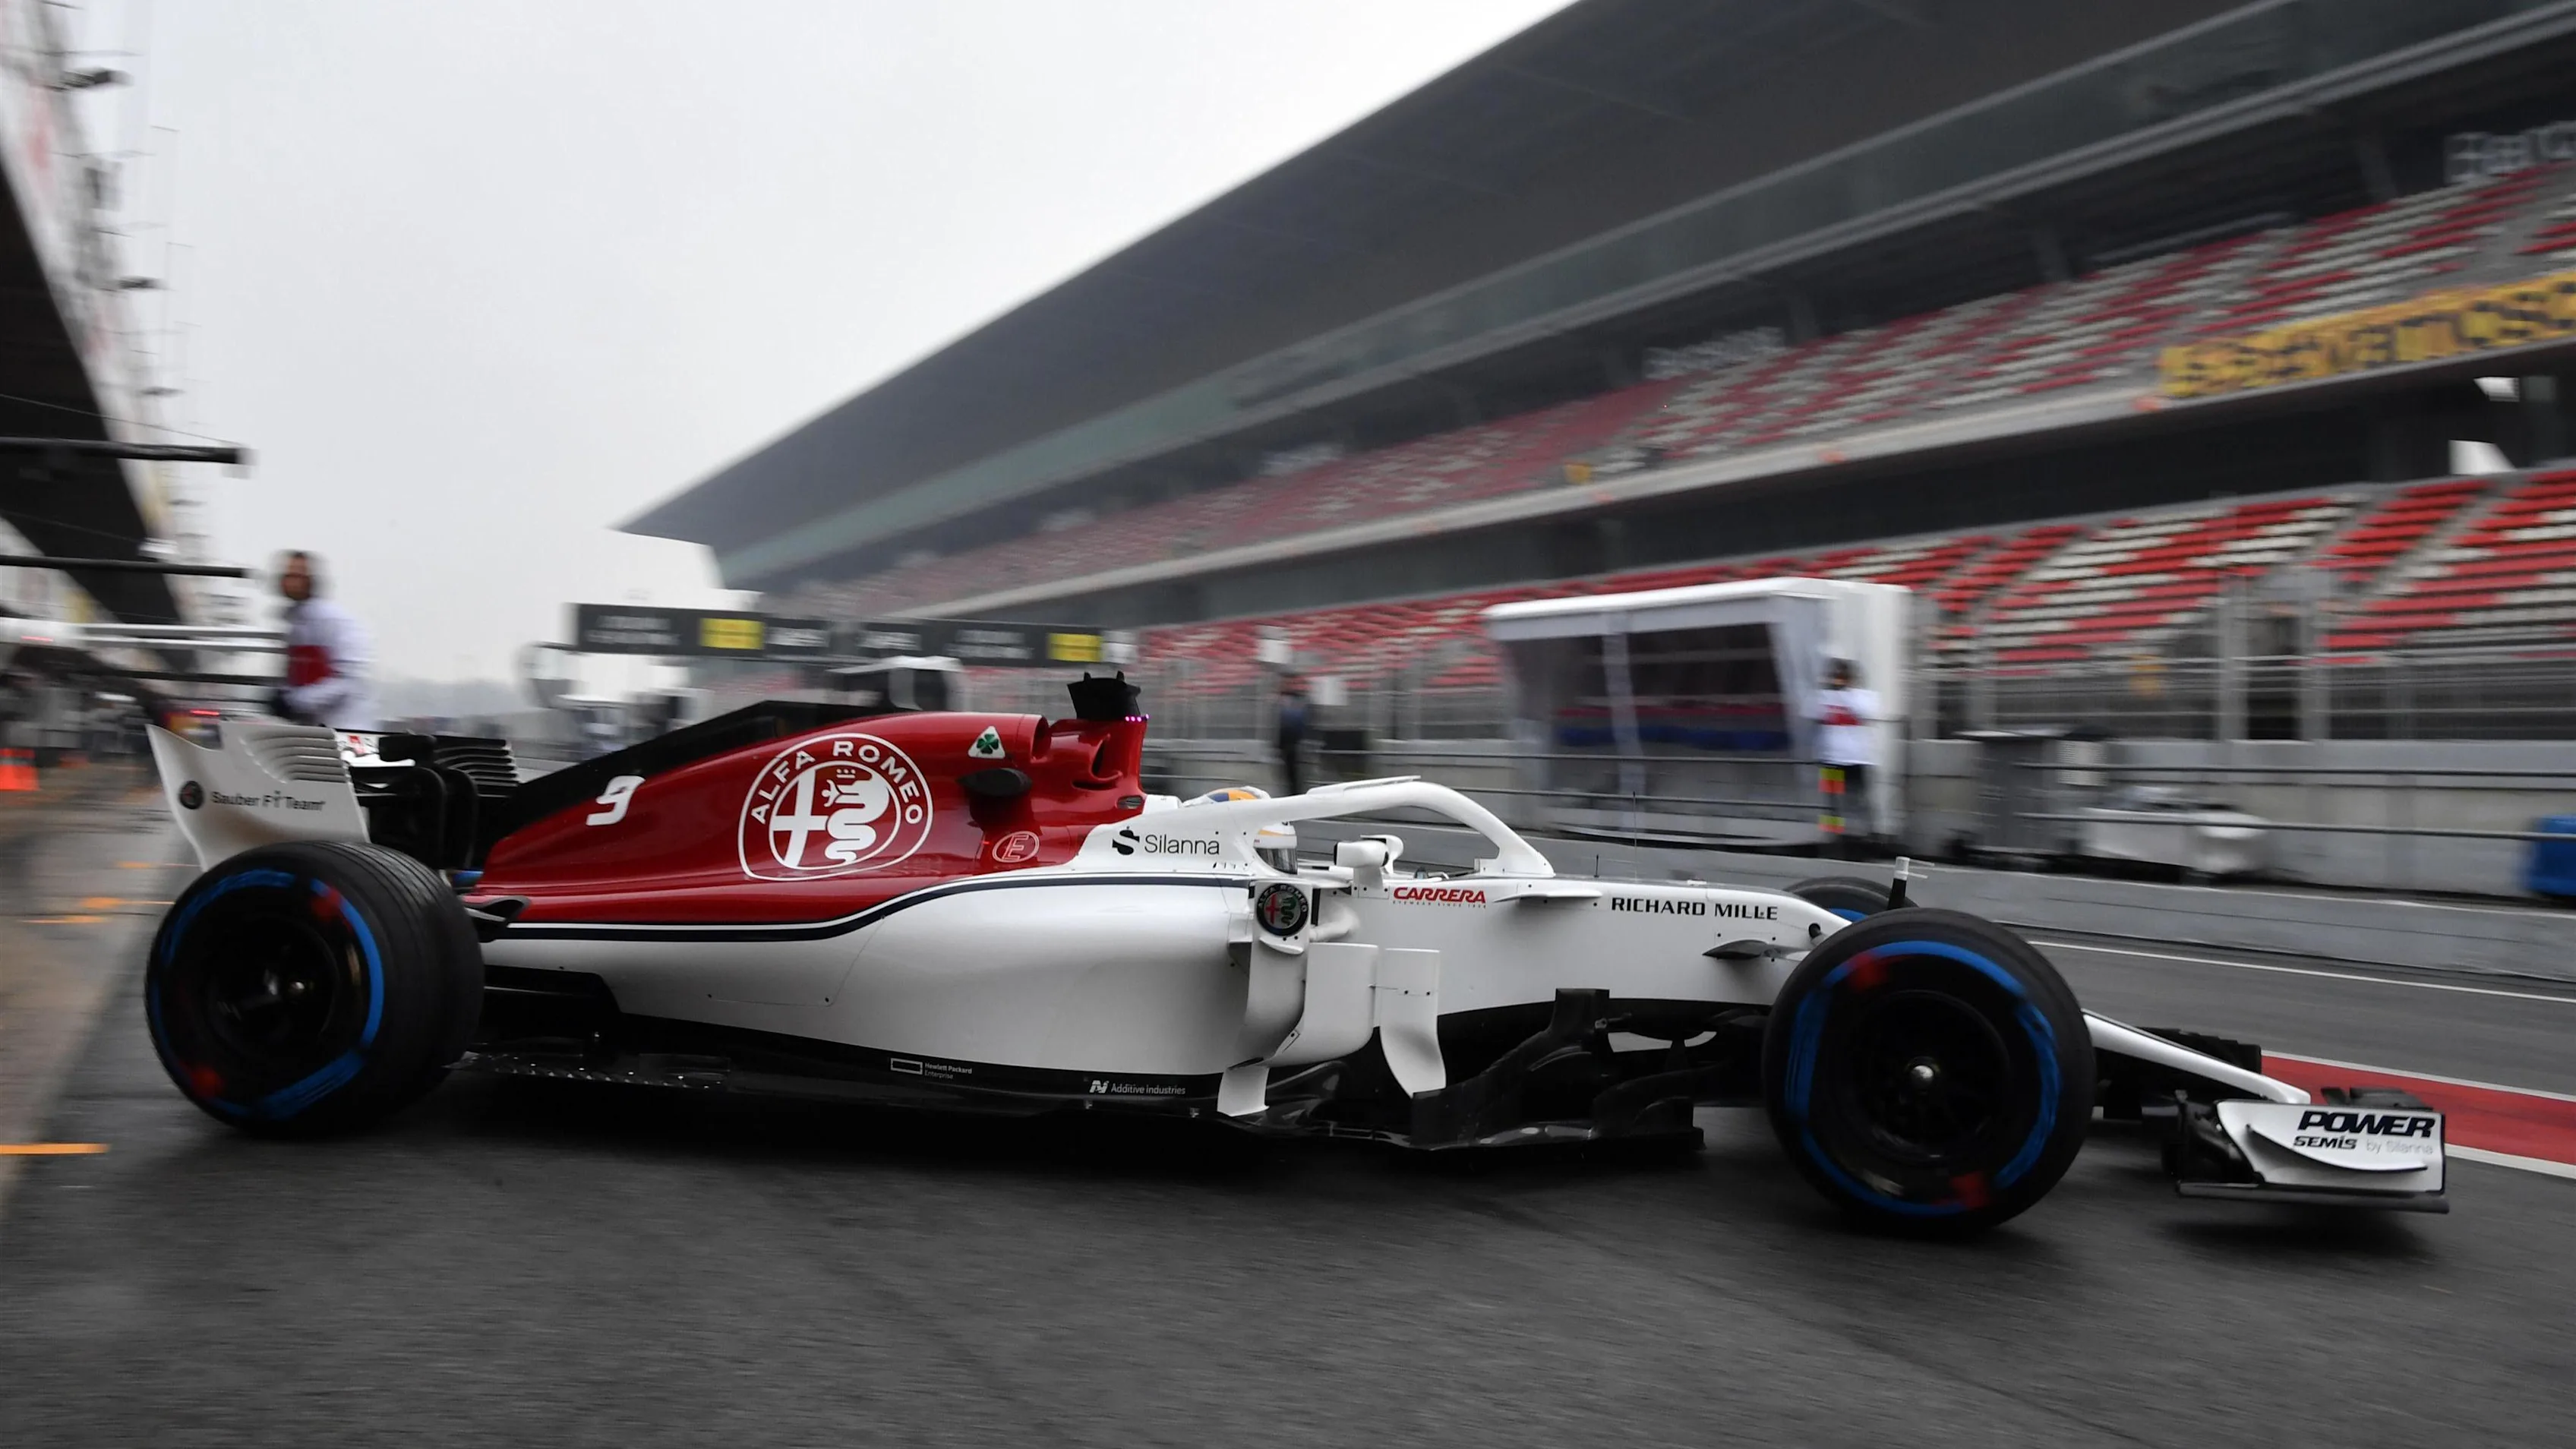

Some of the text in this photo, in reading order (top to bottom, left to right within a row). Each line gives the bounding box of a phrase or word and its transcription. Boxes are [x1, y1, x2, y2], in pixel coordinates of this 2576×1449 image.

[750, 740, 923, 825] ALFA ROMEO
[210, 791, 260, 807] Sauber
[284, 796, 327, 811] Team
[586, 775, 646, 826] 9
[1144, 834, 1220, 855] Silanna
[1393, 886, 1486, 904] CARRERA
[1611, 897, 1779, 920] RICHARD MILLE
[1110, 1083, 1145, 1094] Additive
[2297, 1110, 2436, 1138] POWER
[2366, 1138, 2382, 1154] by
